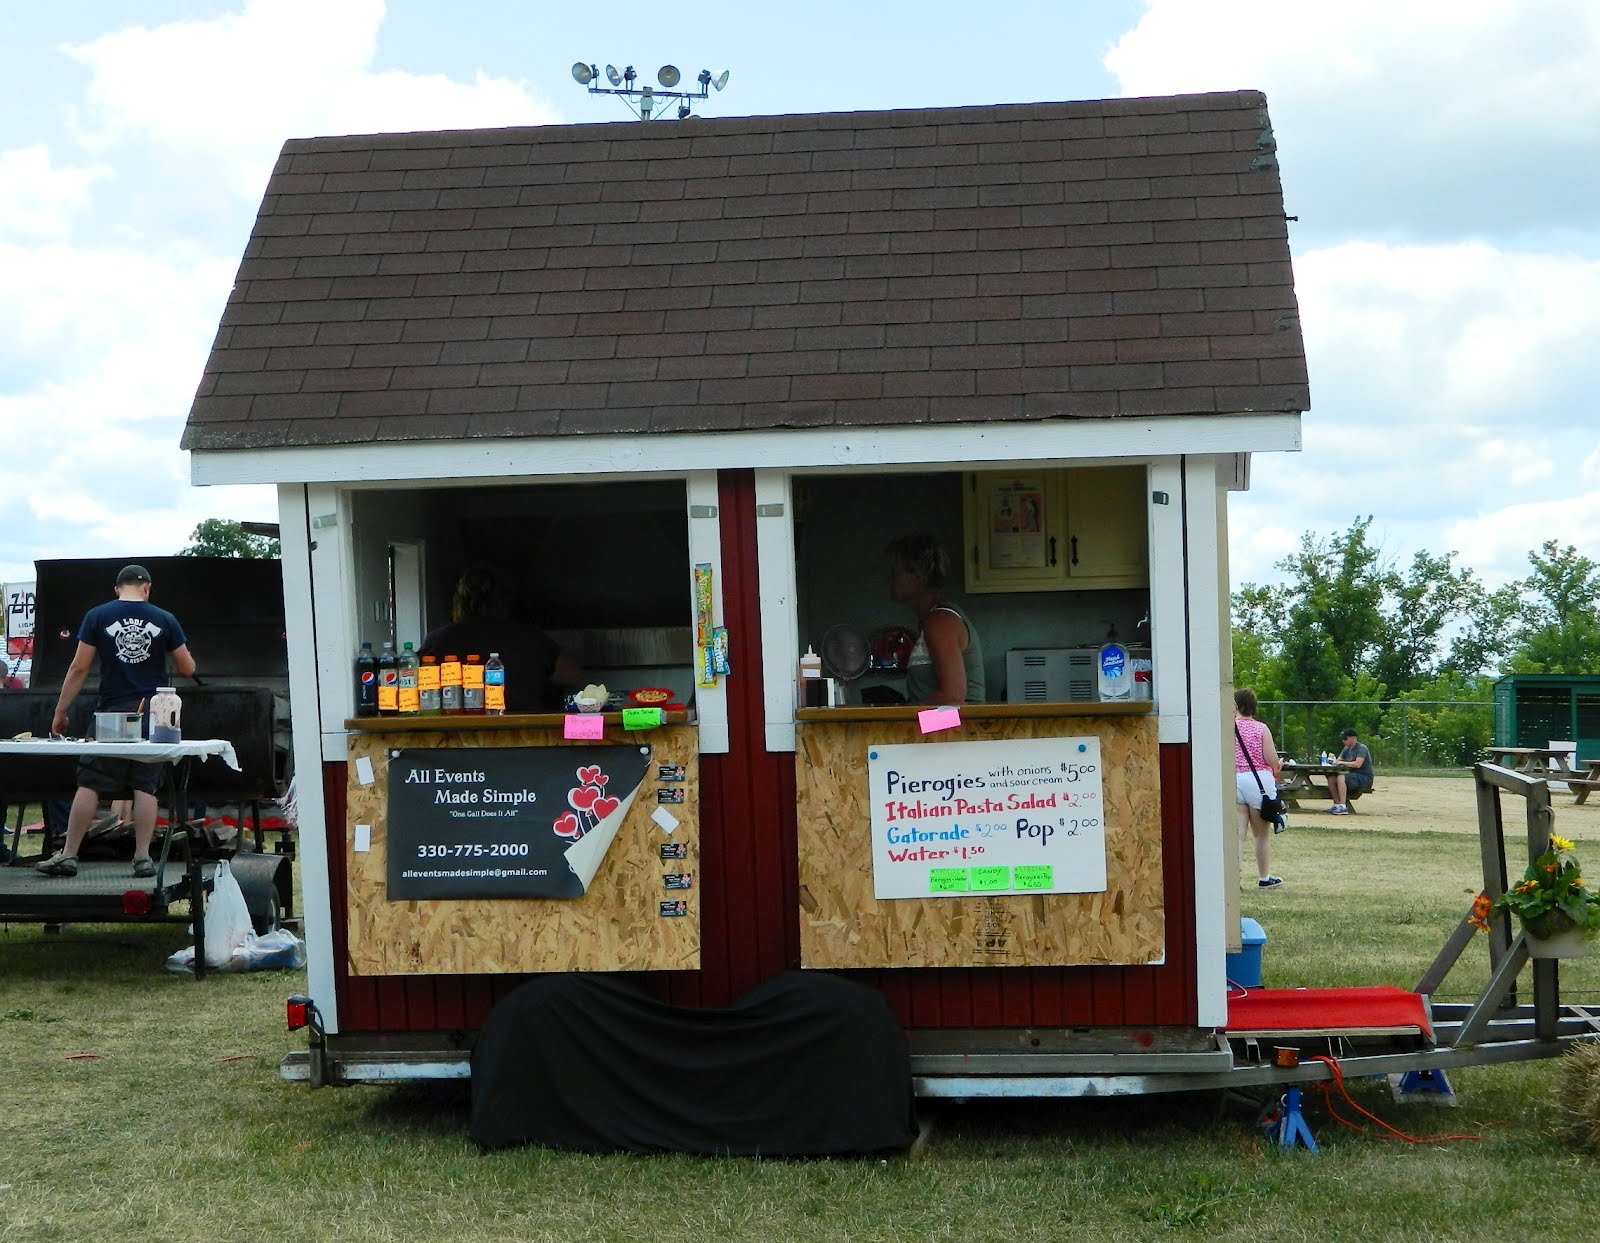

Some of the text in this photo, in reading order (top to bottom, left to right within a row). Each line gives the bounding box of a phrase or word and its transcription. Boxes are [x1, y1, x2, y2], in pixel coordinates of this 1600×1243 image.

[123, 618, 144, 626] LODI
[405, 768, 486, 784] All Events
[887, 771, 986, 800] Pierogies
[988, 766, 1013, 777] with
[1017, 765, 1052, 776] onions
[989, 776, 1063, 788] and sour cream
[434, 788, 537, 806] Made Simple
[467, 810, 480, 818] Call
[885, 800, 953, 821] Italian
[954, 798, 1004, 815] Pasta
[1007, 793, 1057, 810] Salad
[887, 824, 971, 844] Gatorade
[1016, 818, 1055, 846] Pop
[417, 843, 529, 858] 330-775-2000
[888, 846, 950, 863] Water
[402, 867, 548, 878] alleventsmadesimple@gmail.com
